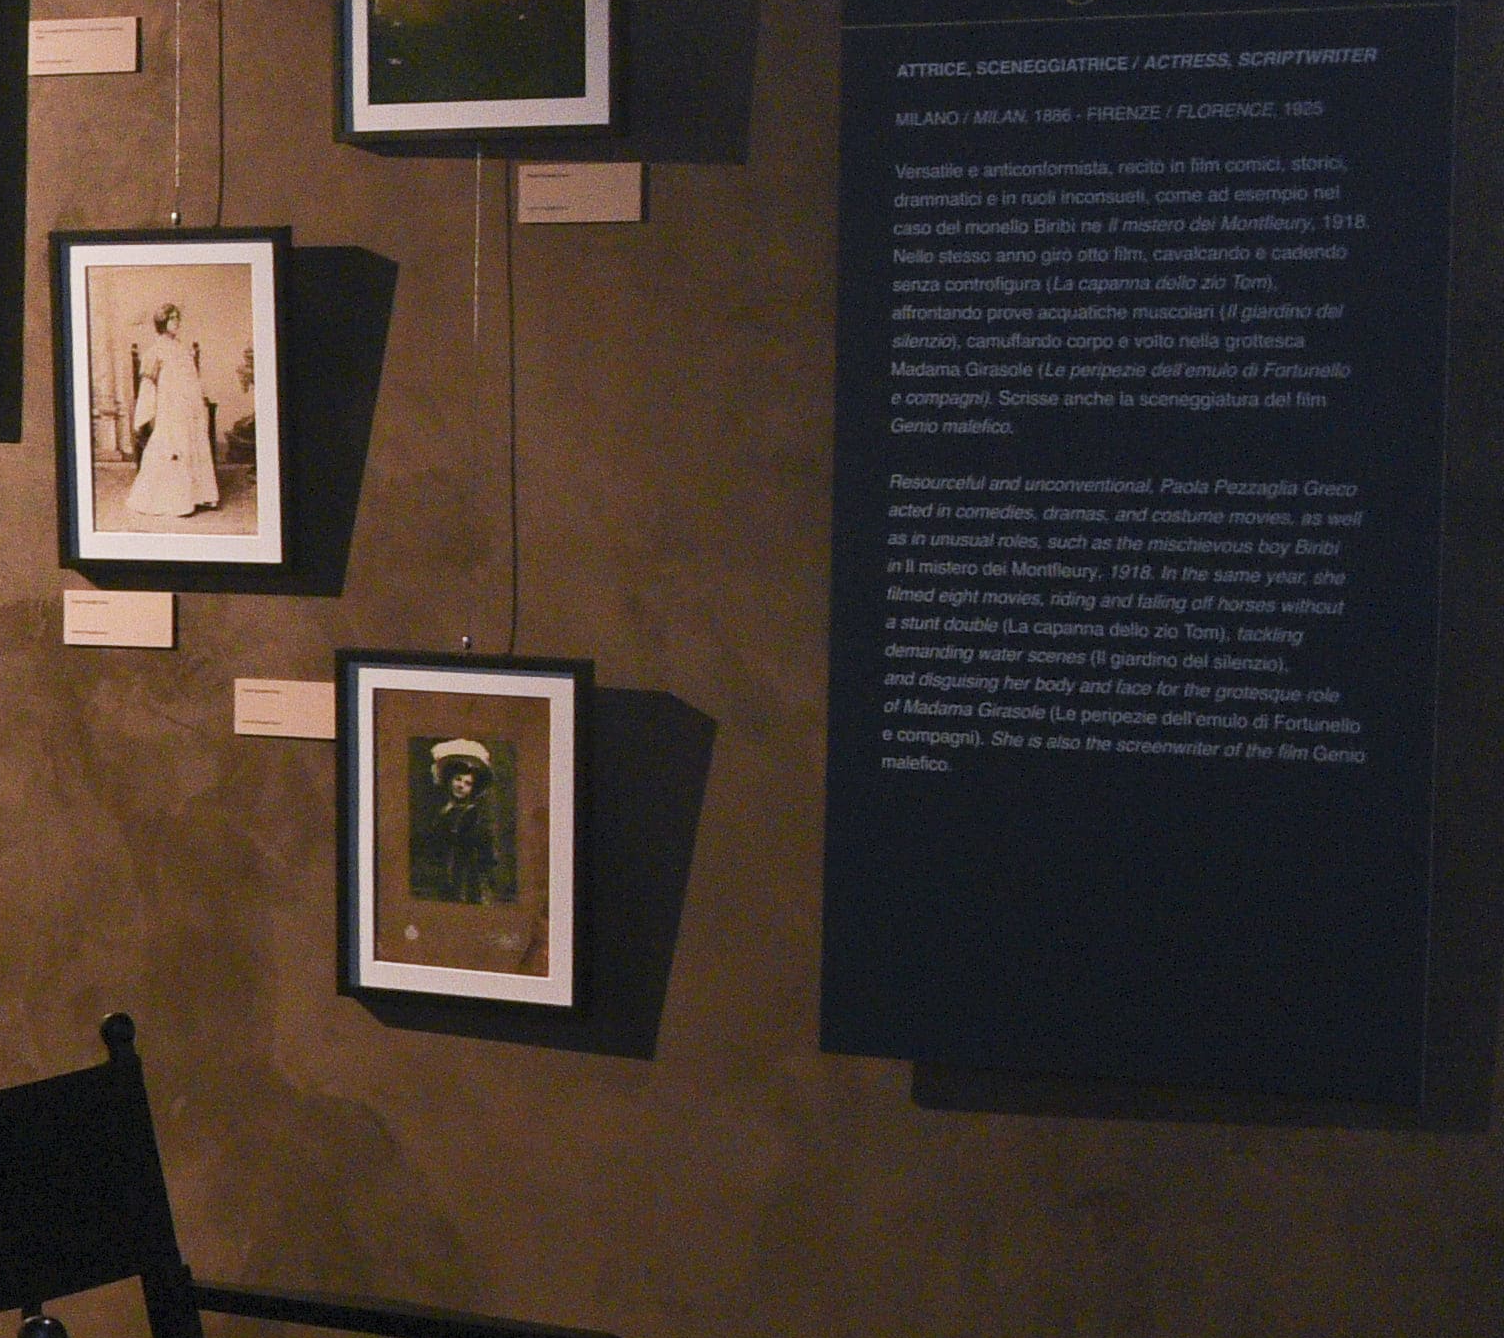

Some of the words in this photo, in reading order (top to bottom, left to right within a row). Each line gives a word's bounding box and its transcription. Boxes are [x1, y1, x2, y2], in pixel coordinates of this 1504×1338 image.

[976, 55, 1127, 75] SCENEGGIATRICE
[1239, 48, 1376, 67] SCRIPTWRITER
[895, 109, 959, 126] MILANO
[1086, 105, 1160, 121] FIRENZE
[892, 248, 934, 263] Nello
[938, 248, 990, 263] stesso
[996, 250, 1036, 262] anno
[1077, 247, 1108, 262] otto
[1153, 246, 1249, 261] cavalcando
[1255, 249, 1265, 260] e
[1271, 245, 1346, 260] cadendo
[892, 305, 981, 319] affrontando
[986, 308, 1032, 323] prove
[1038, 305, 1126, 323] acquatiche
[1132, 305, 1213, 319] muscolari
[1241, 305, 1310, 323] giardino
[1317, 305, 1342, 319] del
[890, 362, 960, 377] Madama
[965, 362, 1032, 377] Girasole
[1038, 362, 1065, 380] (Le
[1069, 362, 1145, 381] peripezie
[1242, 363, 1257, 377] di
[1263, 363, 1349, 378] Fortunello
[889, 475, 985, 491] Resourceful
[989, 476, 1020, 491] and
[1160, 479, 1208, 494] Paola
[1214, 480, 1297, 500] Pezzaglia
[1304, 481, 1355, 497] Greco
